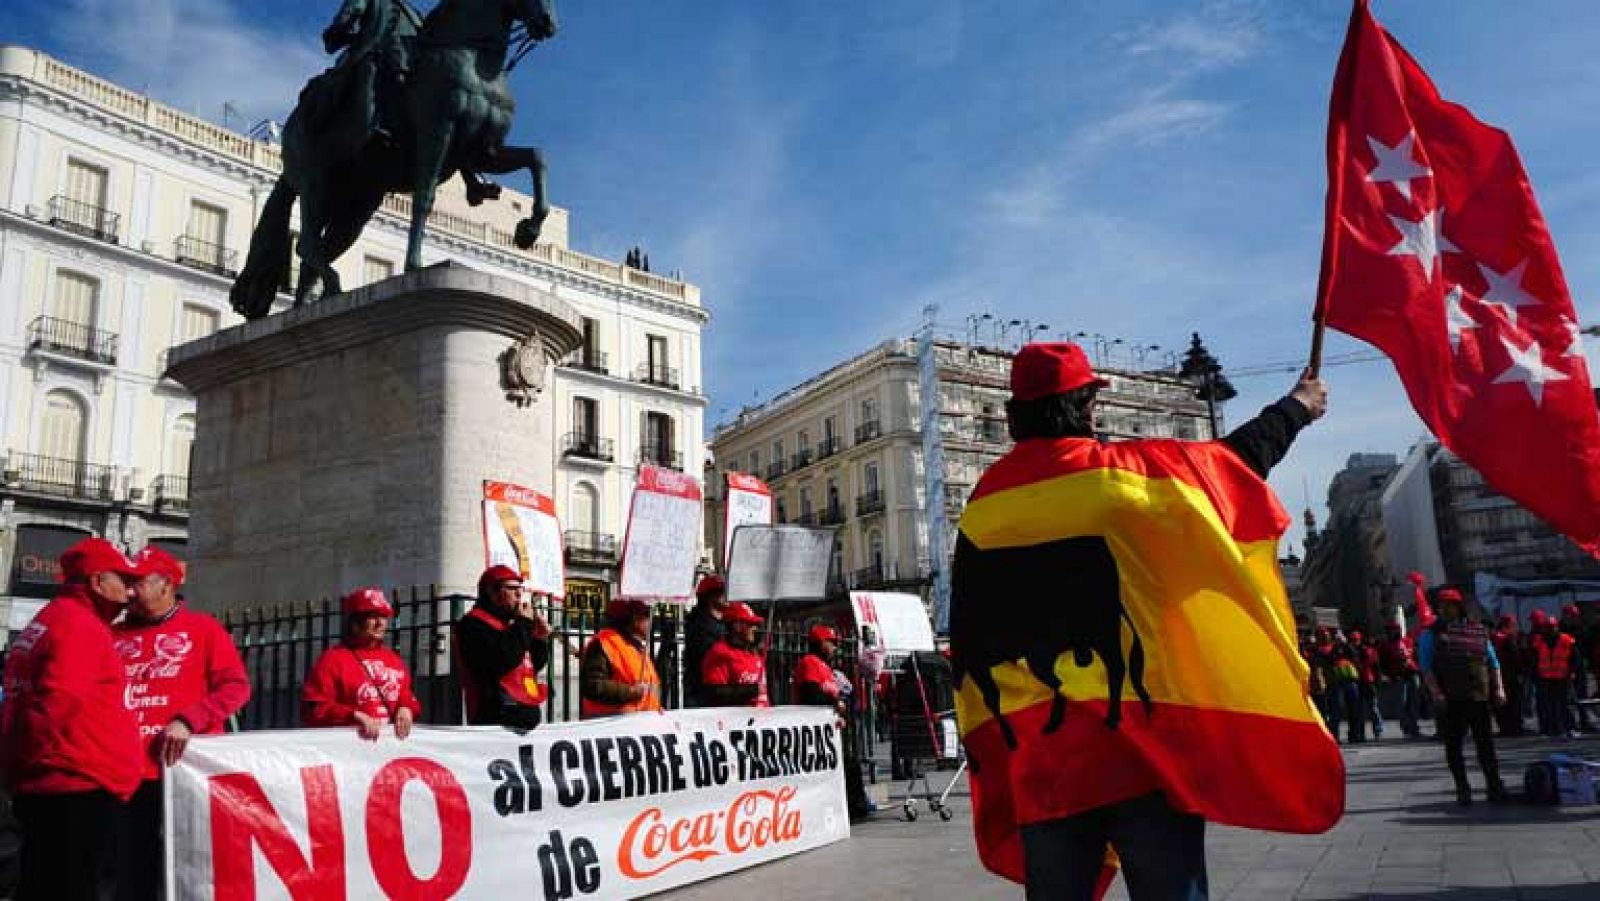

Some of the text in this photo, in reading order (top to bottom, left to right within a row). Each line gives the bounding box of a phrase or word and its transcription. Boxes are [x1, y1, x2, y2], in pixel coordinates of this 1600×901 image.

[488, 717, 838, 816] al CIERRE de FÁBRICAS
[208, 757, 472, 901] NO
[537, 829, 601, 901] de
[616, 784, 802, 880] Coca-Cola
